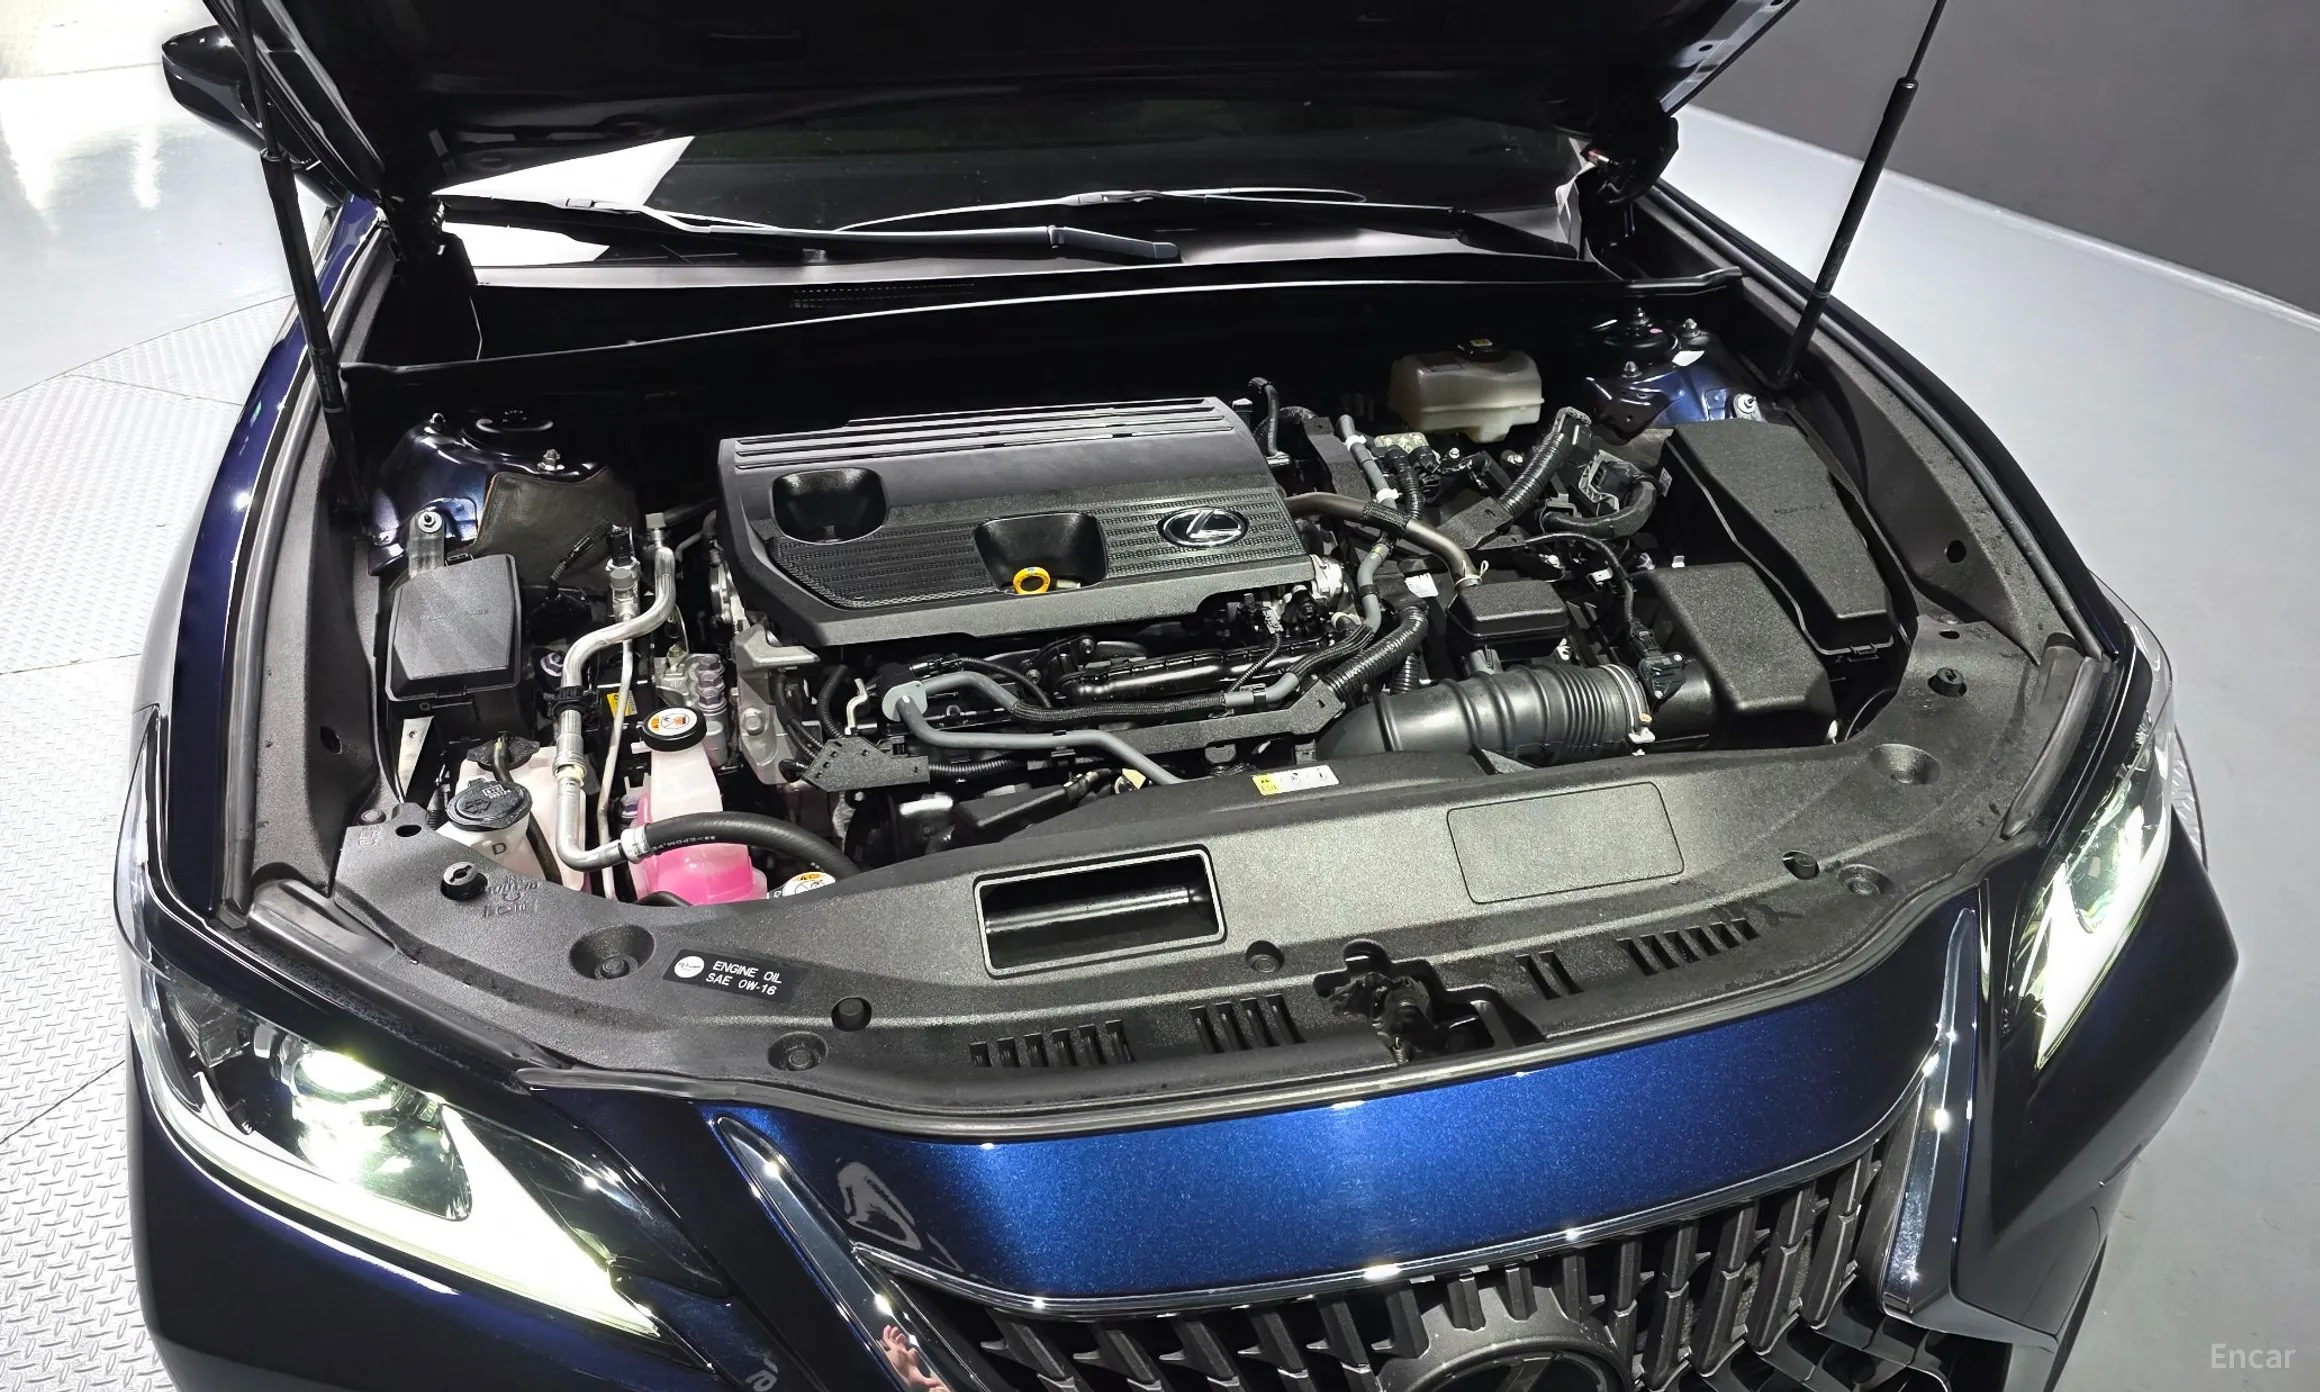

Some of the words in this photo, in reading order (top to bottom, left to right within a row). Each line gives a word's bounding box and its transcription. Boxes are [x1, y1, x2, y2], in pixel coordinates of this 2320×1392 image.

[712, 960, 758, 978] ENGINE
[763, 971, 782, 984] OIL
[706, 973, 732, 986] SAE
[738, 979, 777, 996] 0W-16
